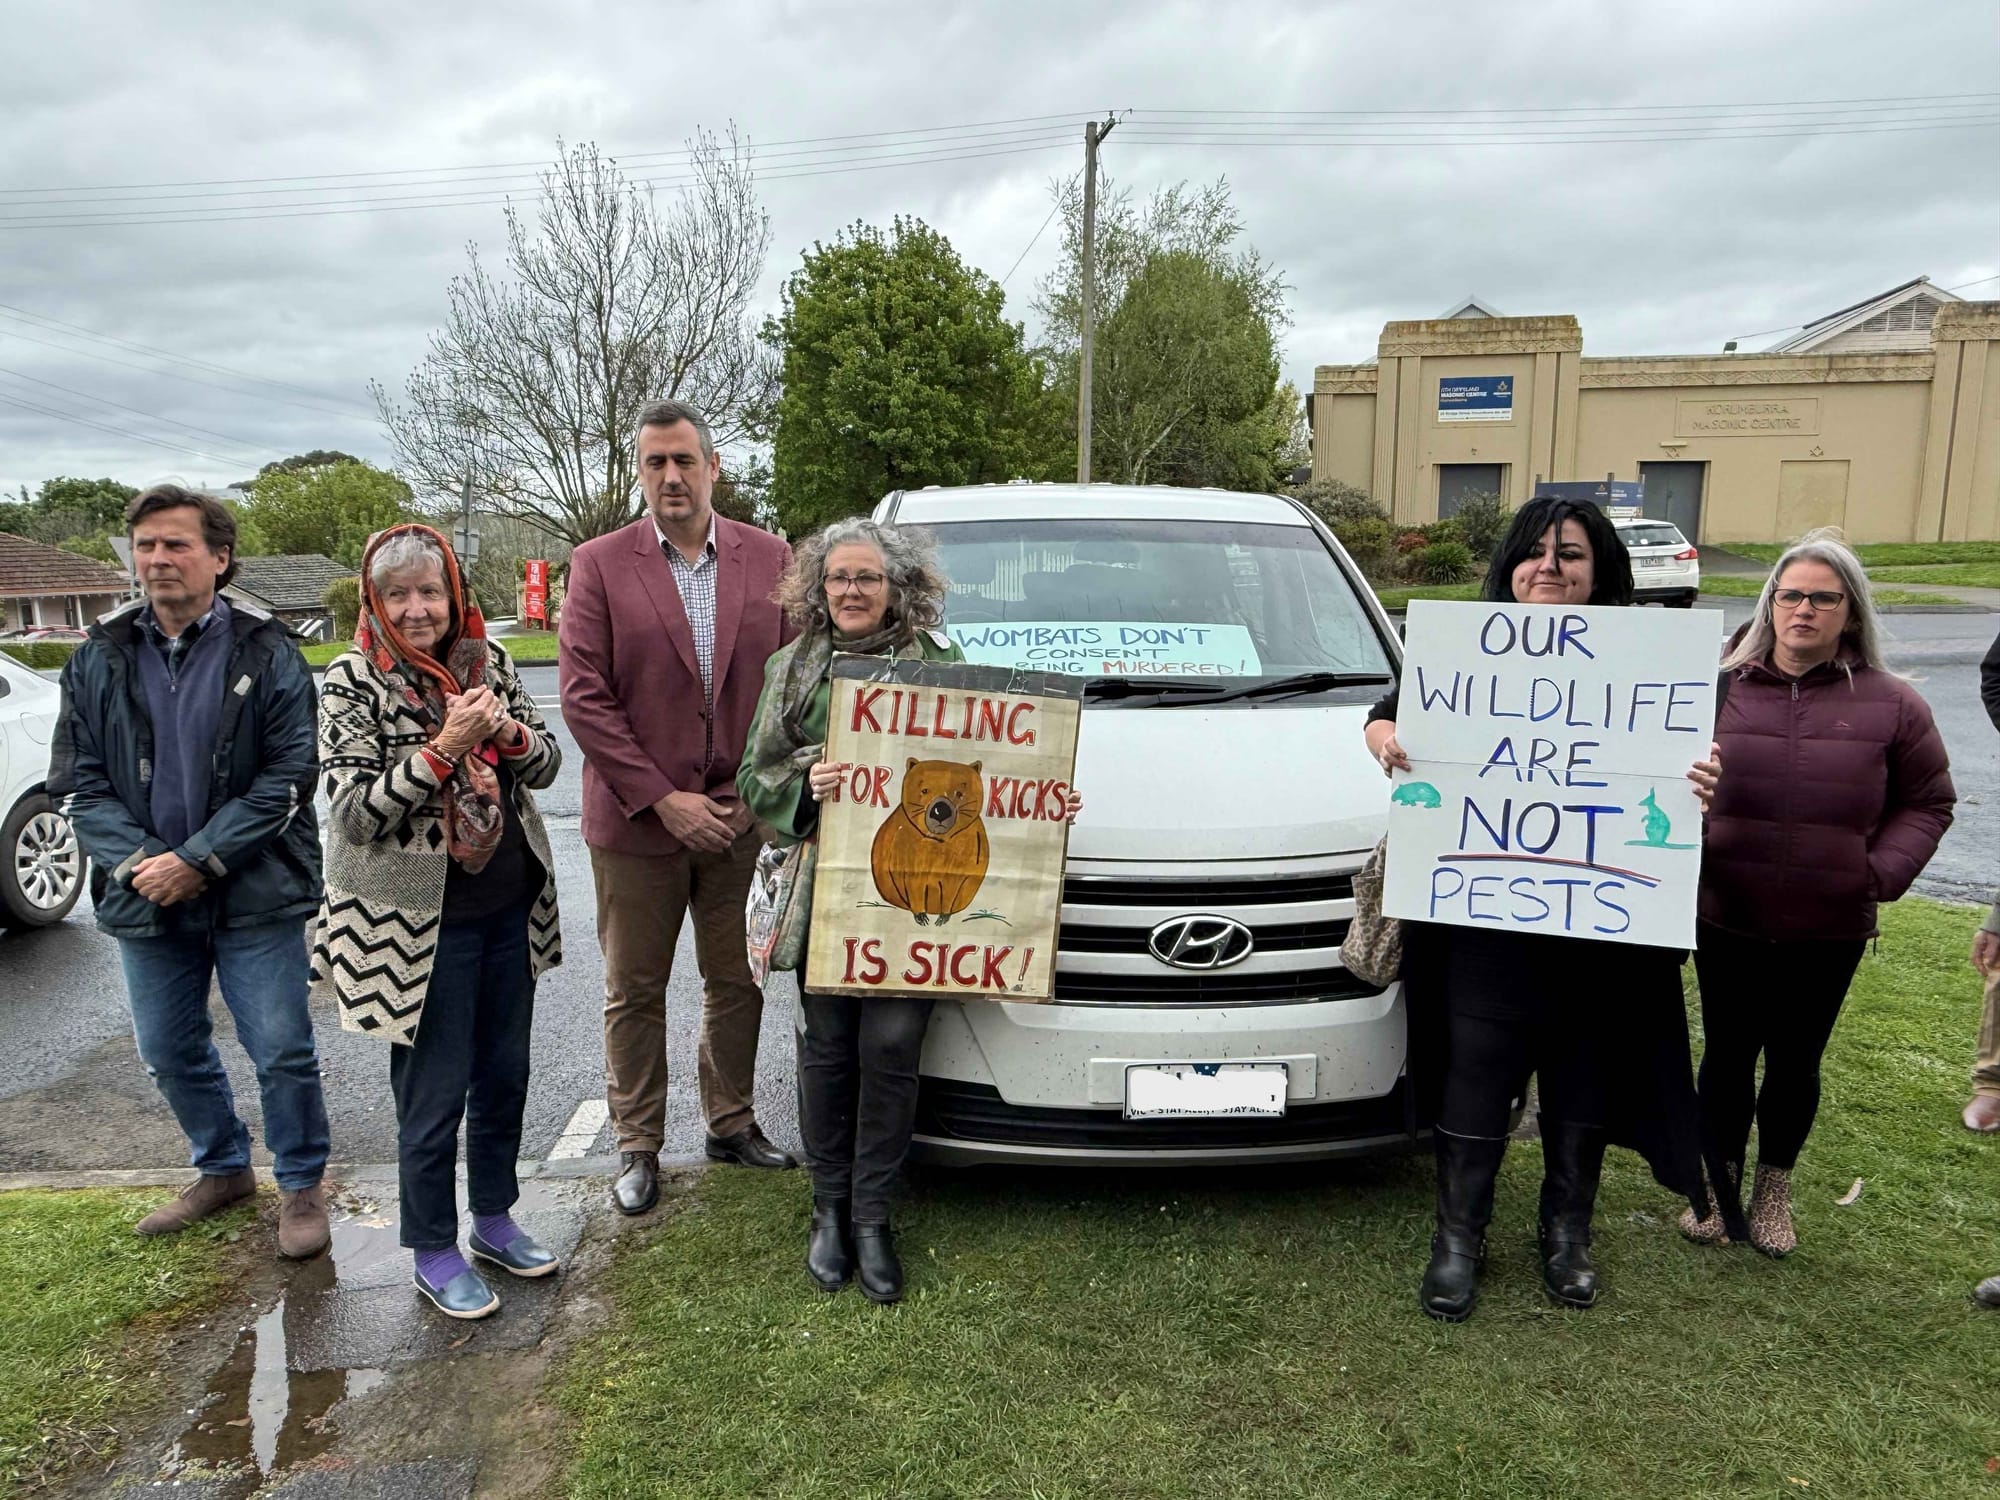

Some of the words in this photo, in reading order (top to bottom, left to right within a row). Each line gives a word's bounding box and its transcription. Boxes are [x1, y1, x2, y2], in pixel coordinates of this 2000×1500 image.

[1750, 418, 1801, 429] CENTRE
[956, 627, 1102, 648] WOMBATS
[1120, 626, 1211, 645] DON'T
[1026, 648, 1170, 660] CONSENT
[1480, 611, 1595, 659] OUR
[1103, 660, 1247, 676] MURDERED!
[850, 687, 1036, 746] KILLING
[1417, 666, 1709, 732] WILDLIFE
[1478, 736, 1608, 787] ARE
[986, 776, 1069, 822] KICKS
[1458, 796, 1625, 864] NOT
[1430, 867, 1630, 934] PESTS
[841, 937, 889, 985] IS
[902, 940, 1035, 990] SICK!
